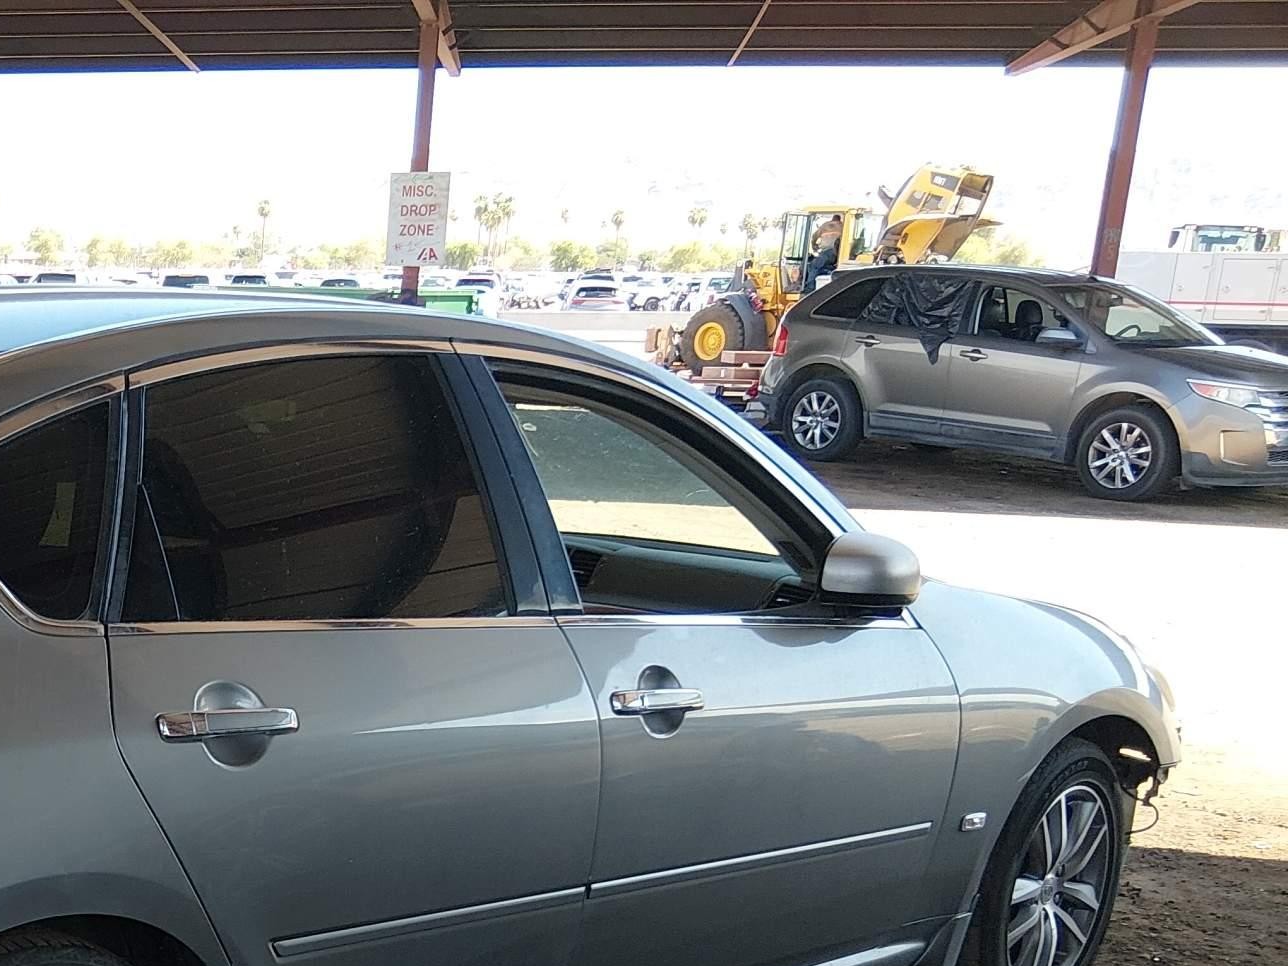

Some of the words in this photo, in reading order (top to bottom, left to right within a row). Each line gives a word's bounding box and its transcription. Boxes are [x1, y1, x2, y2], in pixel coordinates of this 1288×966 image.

[401, 184, 437, 197] MISC.
[400, 204, 437, 217] DROP
[399, 223, 434, 237] ZONE
